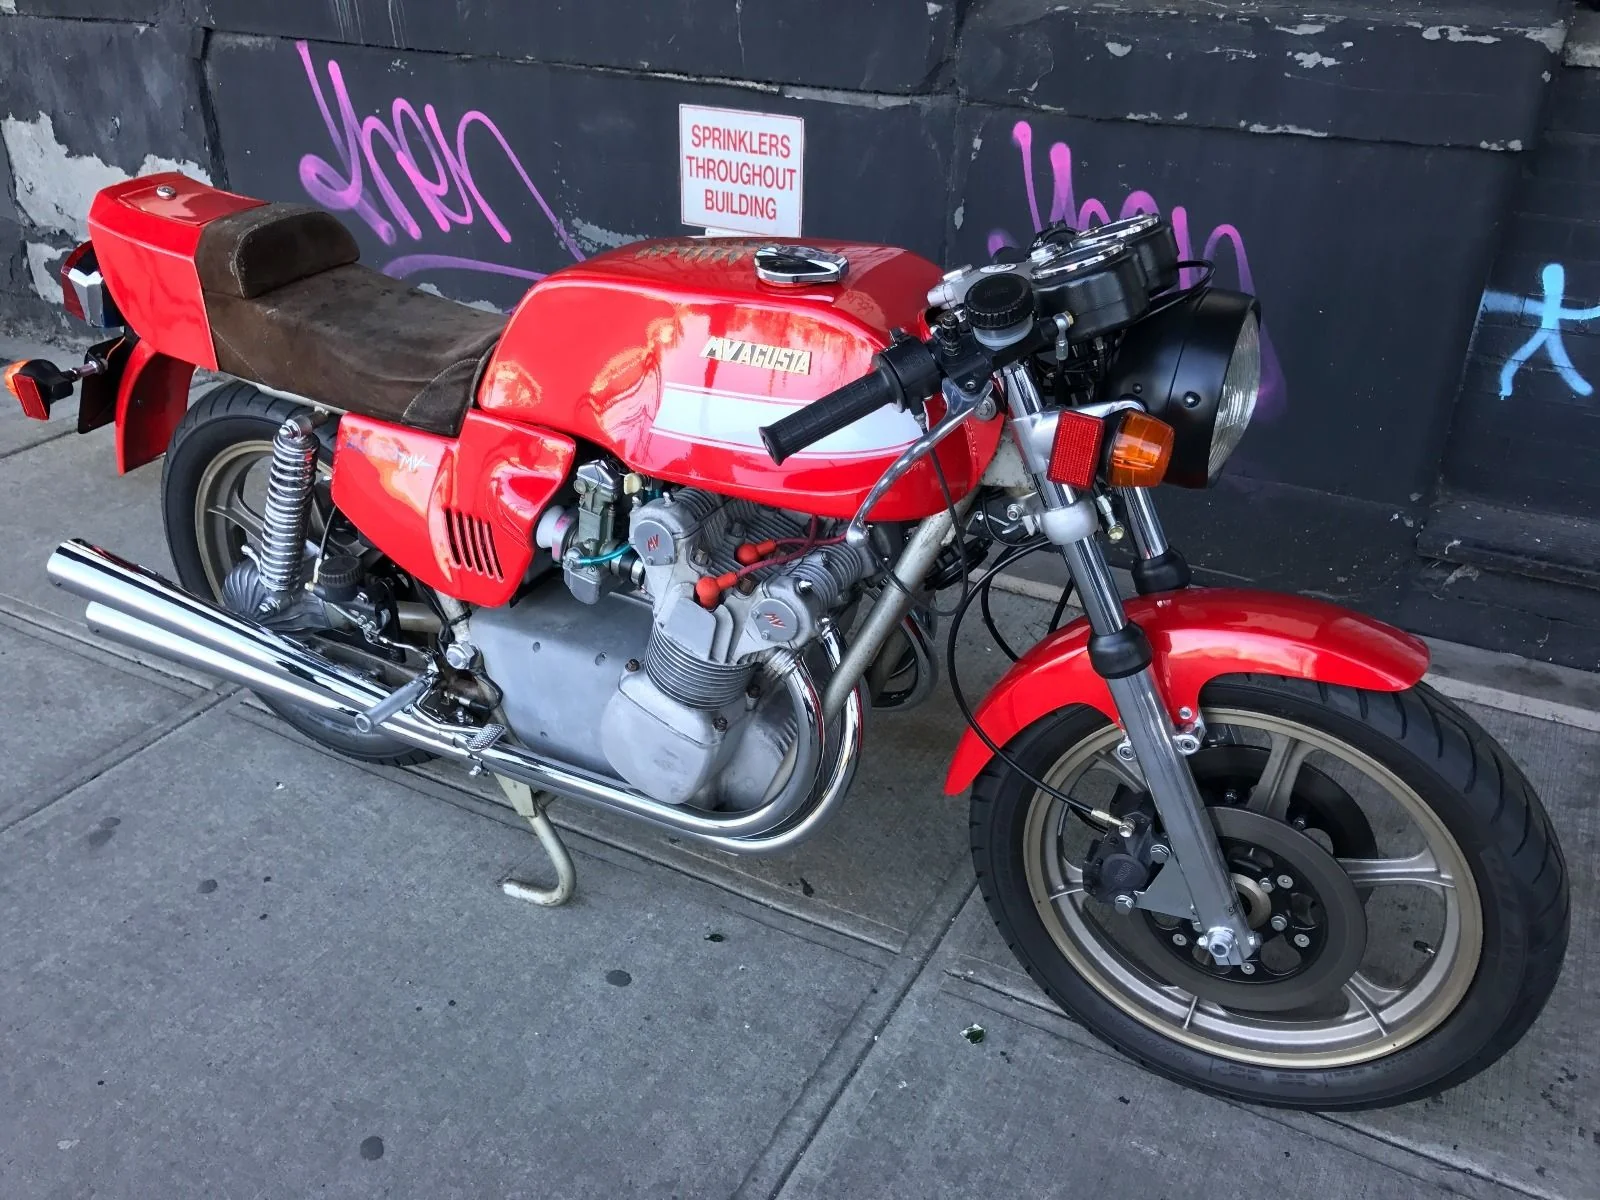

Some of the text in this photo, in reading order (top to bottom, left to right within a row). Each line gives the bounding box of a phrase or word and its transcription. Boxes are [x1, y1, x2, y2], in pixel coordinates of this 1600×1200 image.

[691, 124, 791, 159] SPRINKLERS
[686, 155, 797, 191] THROUGHOUT
[704, 188, 777, 220] BUILDING
[646, 533, 660, 552] MV
[763, 611, 787, 629] MV
